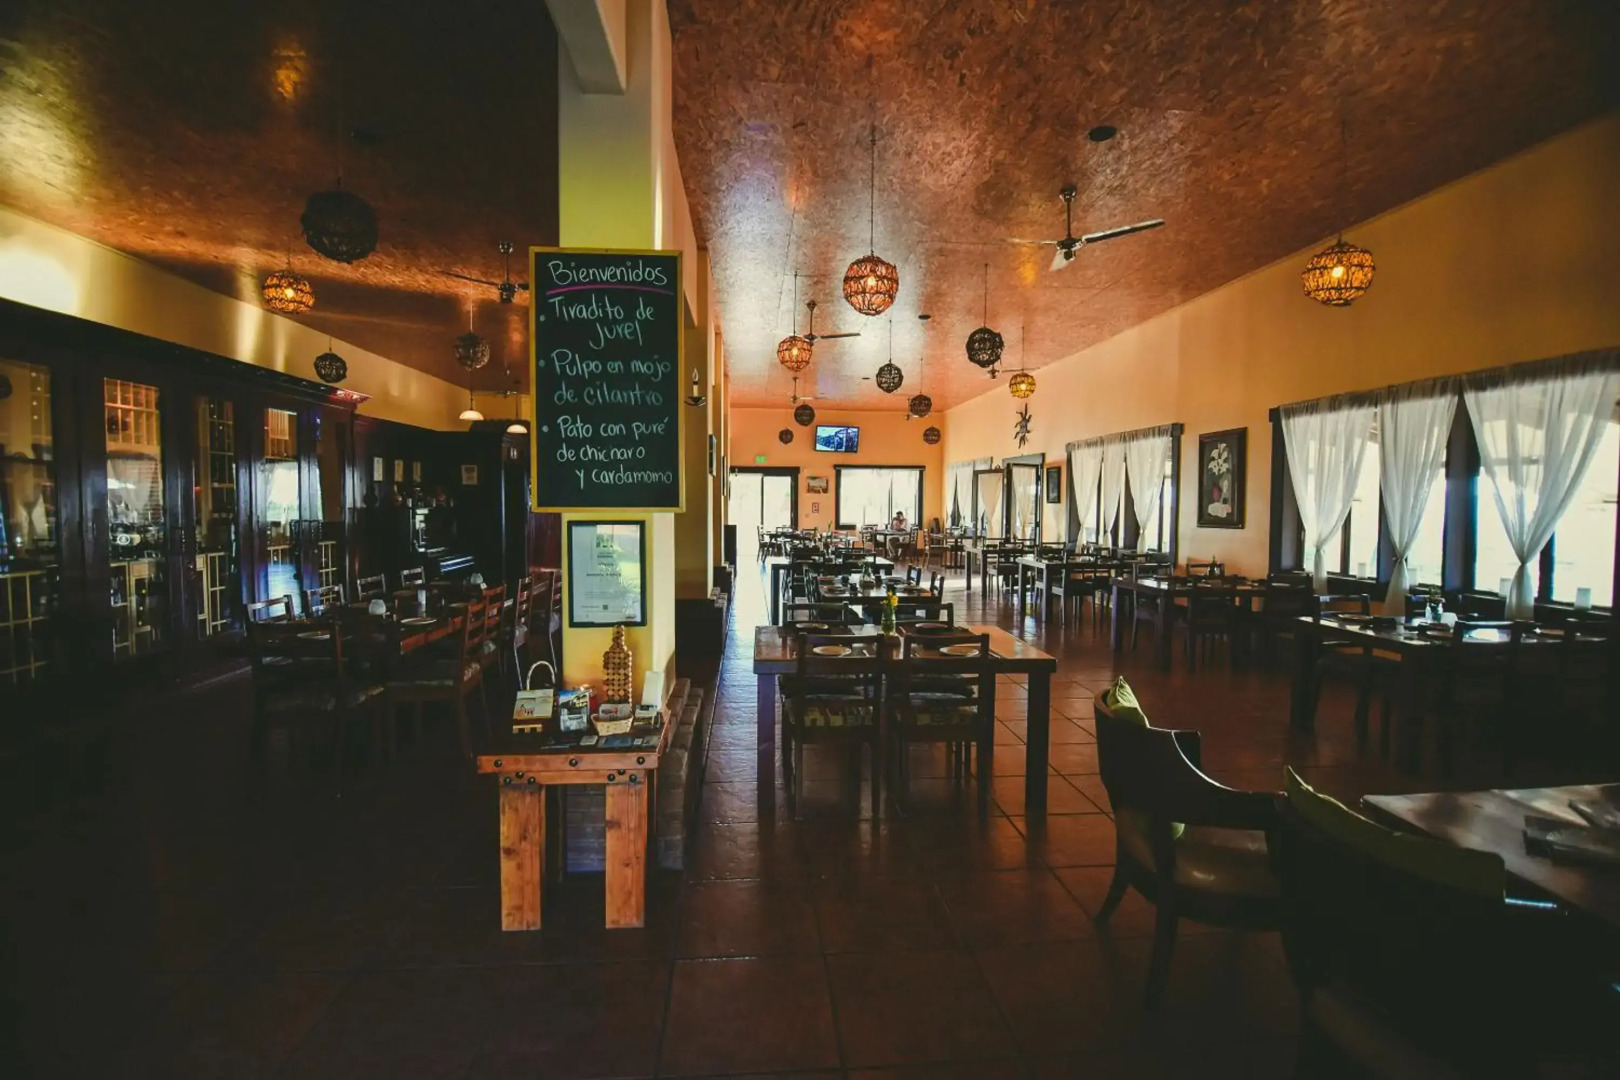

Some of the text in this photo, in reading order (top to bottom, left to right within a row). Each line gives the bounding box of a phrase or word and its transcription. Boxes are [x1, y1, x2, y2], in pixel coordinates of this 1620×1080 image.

[547, 259, 667, 286] Bienvenidos
[548, 293, 655, 322] Tiradito de
[551, 349, 671, 382] Pulpo en mojo
[554, 380, 663, 406] de cilantro
[557, 414, 669, 440] Pato con puré
[557, 442, 576, 462] de
[592, 463, 672, 485] cardamomo
